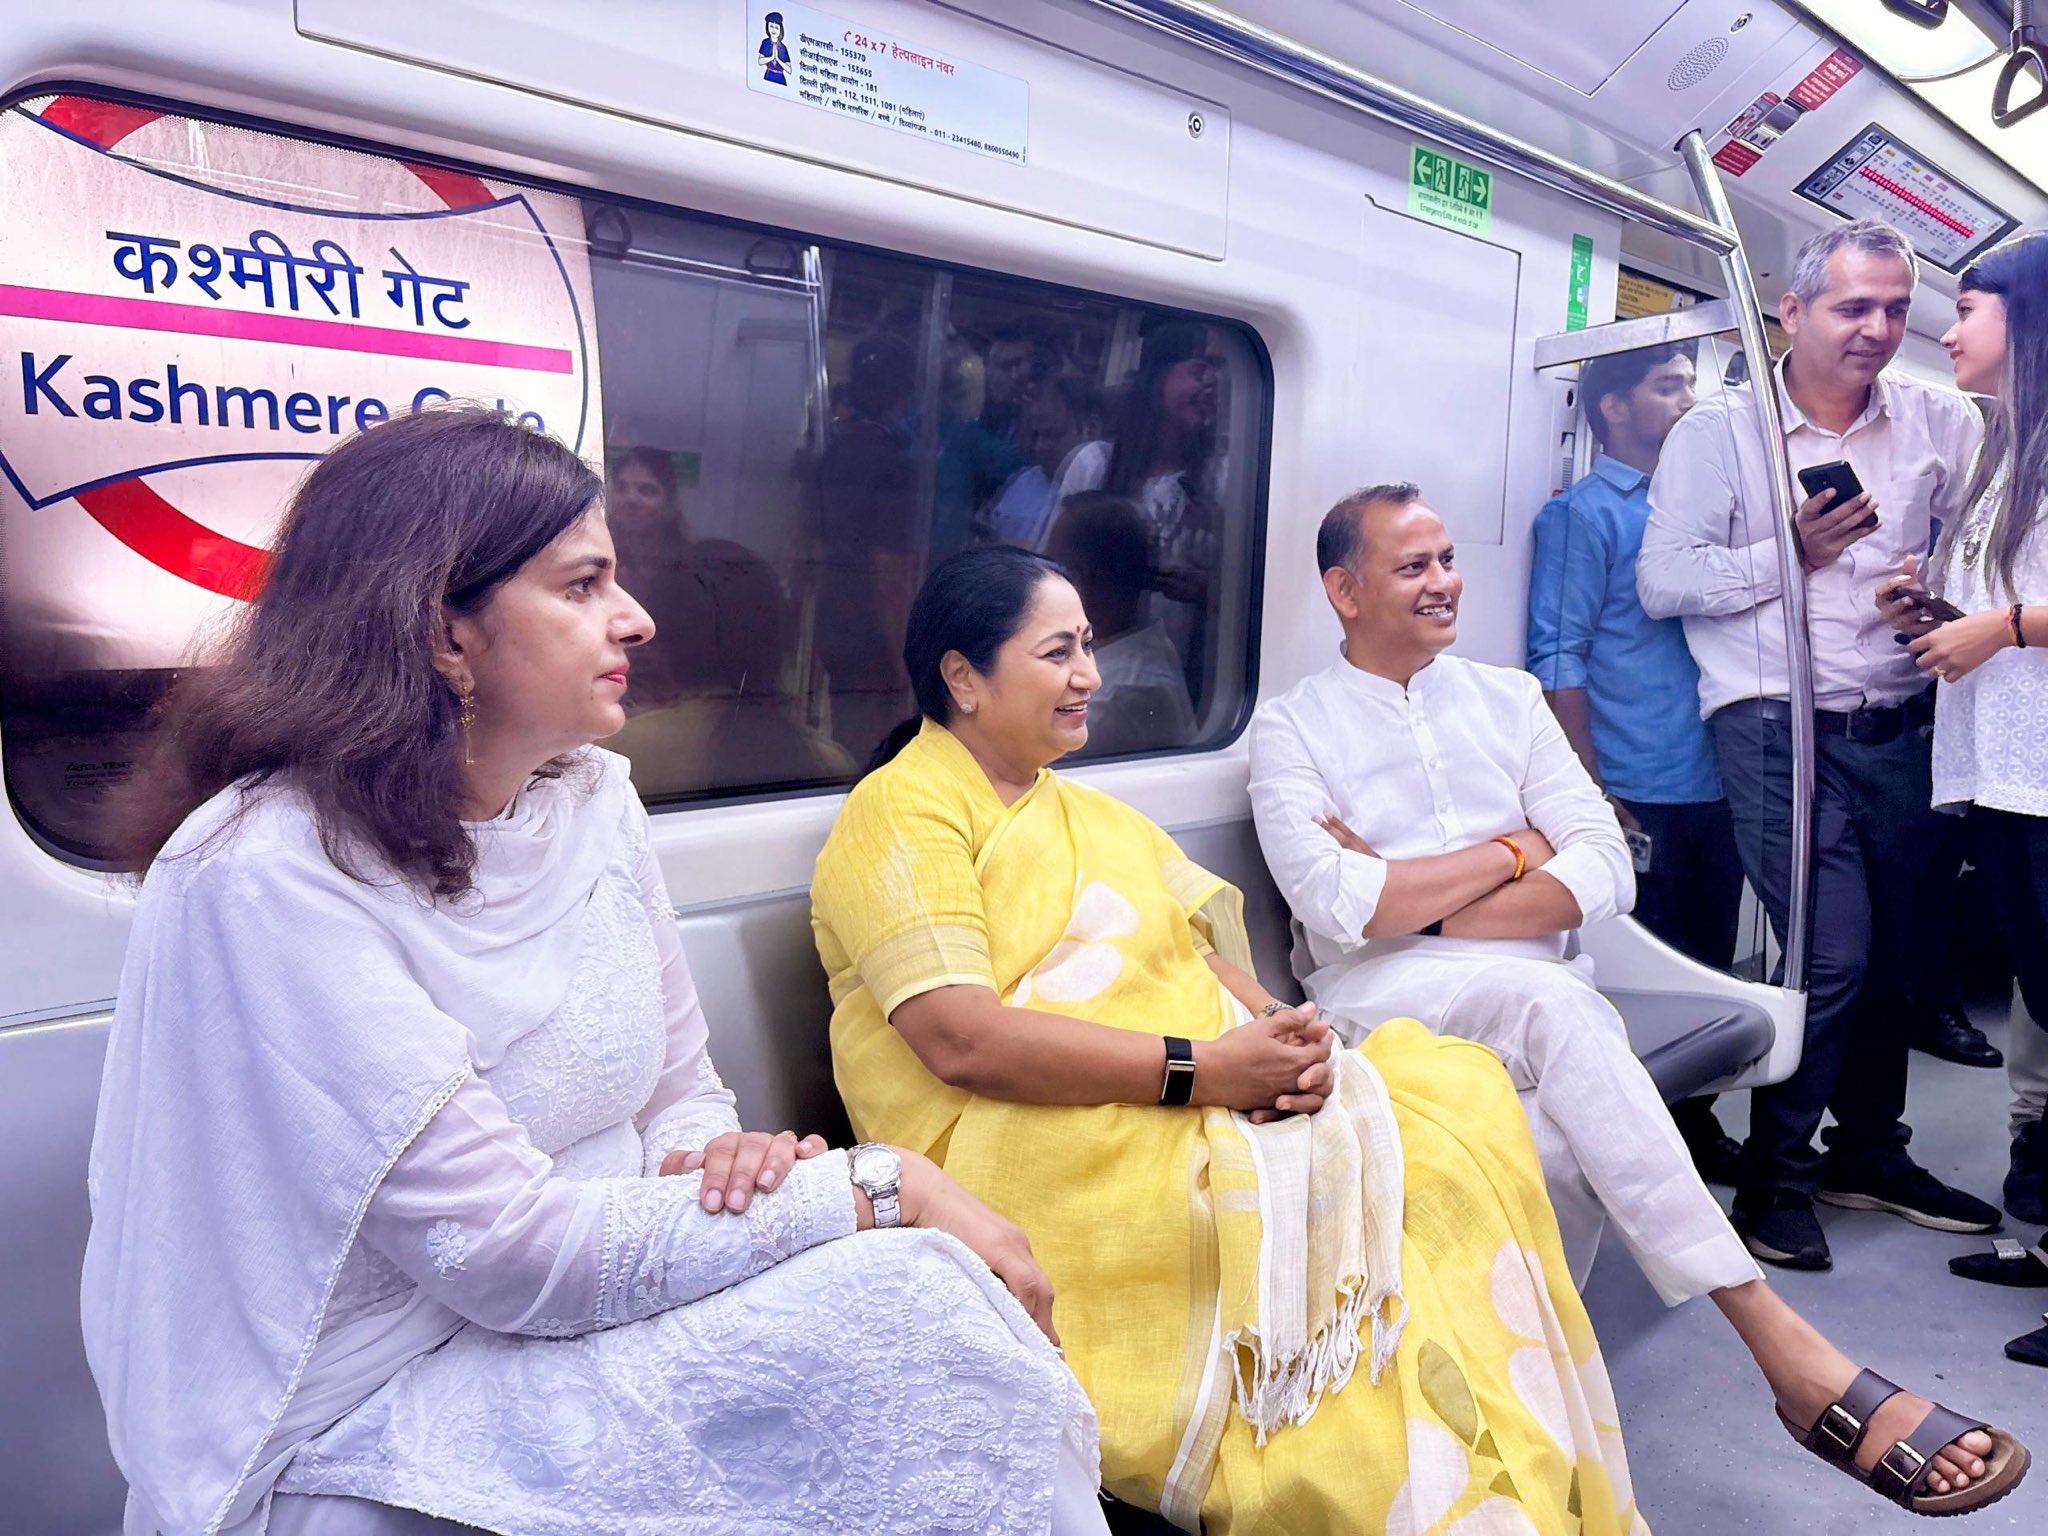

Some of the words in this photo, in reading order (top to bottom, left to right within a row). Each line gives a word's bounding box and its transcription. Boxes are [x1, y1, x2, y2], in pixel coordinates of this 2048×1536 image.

[841, 47, 866, 62] 155370
[855, 34, 868, 48] 24
[880, 42, 887, 54] 7
[891, 42, 934, 69] हेल्पलाइन
[847, 64, 873, 78] 155655
[866, 82, 878, 93] 181
[881, 100, 896, 112] 1091
[934, 129, 946, 139] 011
[105, 229, 364, 318] कश्मीरी
[381, 246, 471, 330] गेट
[21, 351, 390, 435] Kashmere
